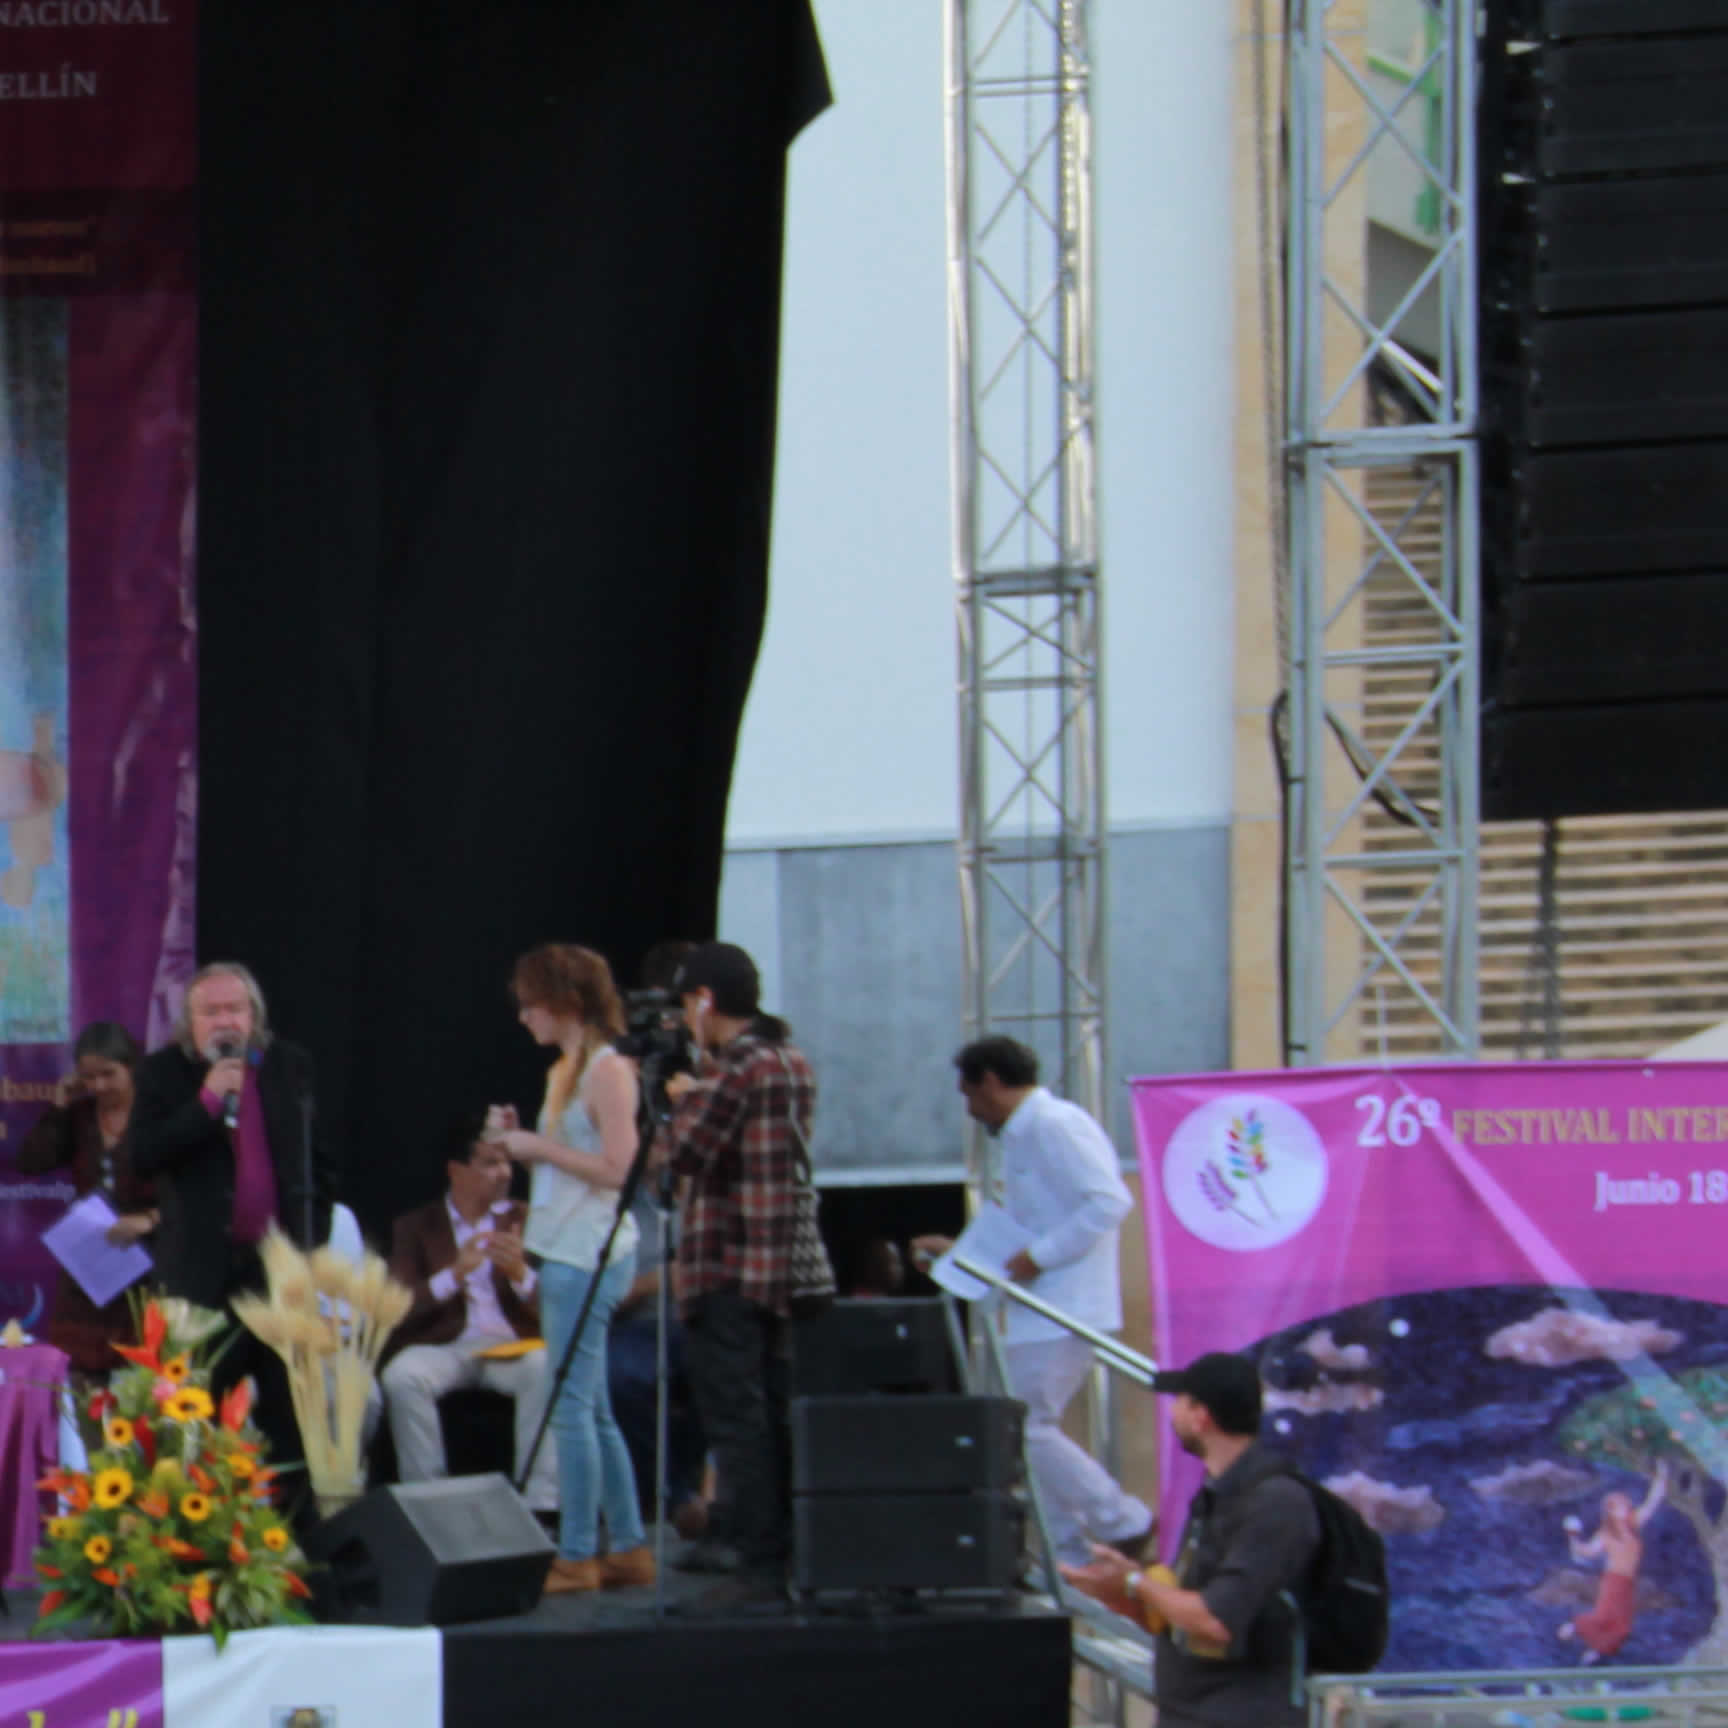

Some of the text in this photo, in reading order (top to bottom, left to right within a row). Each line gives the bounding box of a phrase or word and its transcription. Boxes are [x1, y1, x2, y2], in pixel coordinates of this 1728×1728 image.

[1353, 1093, 1442, 1149] 26º
[1452, 1106, 1621, 1145] FESTIVAL
[1593, 1170, 1682, 1213] Junio
